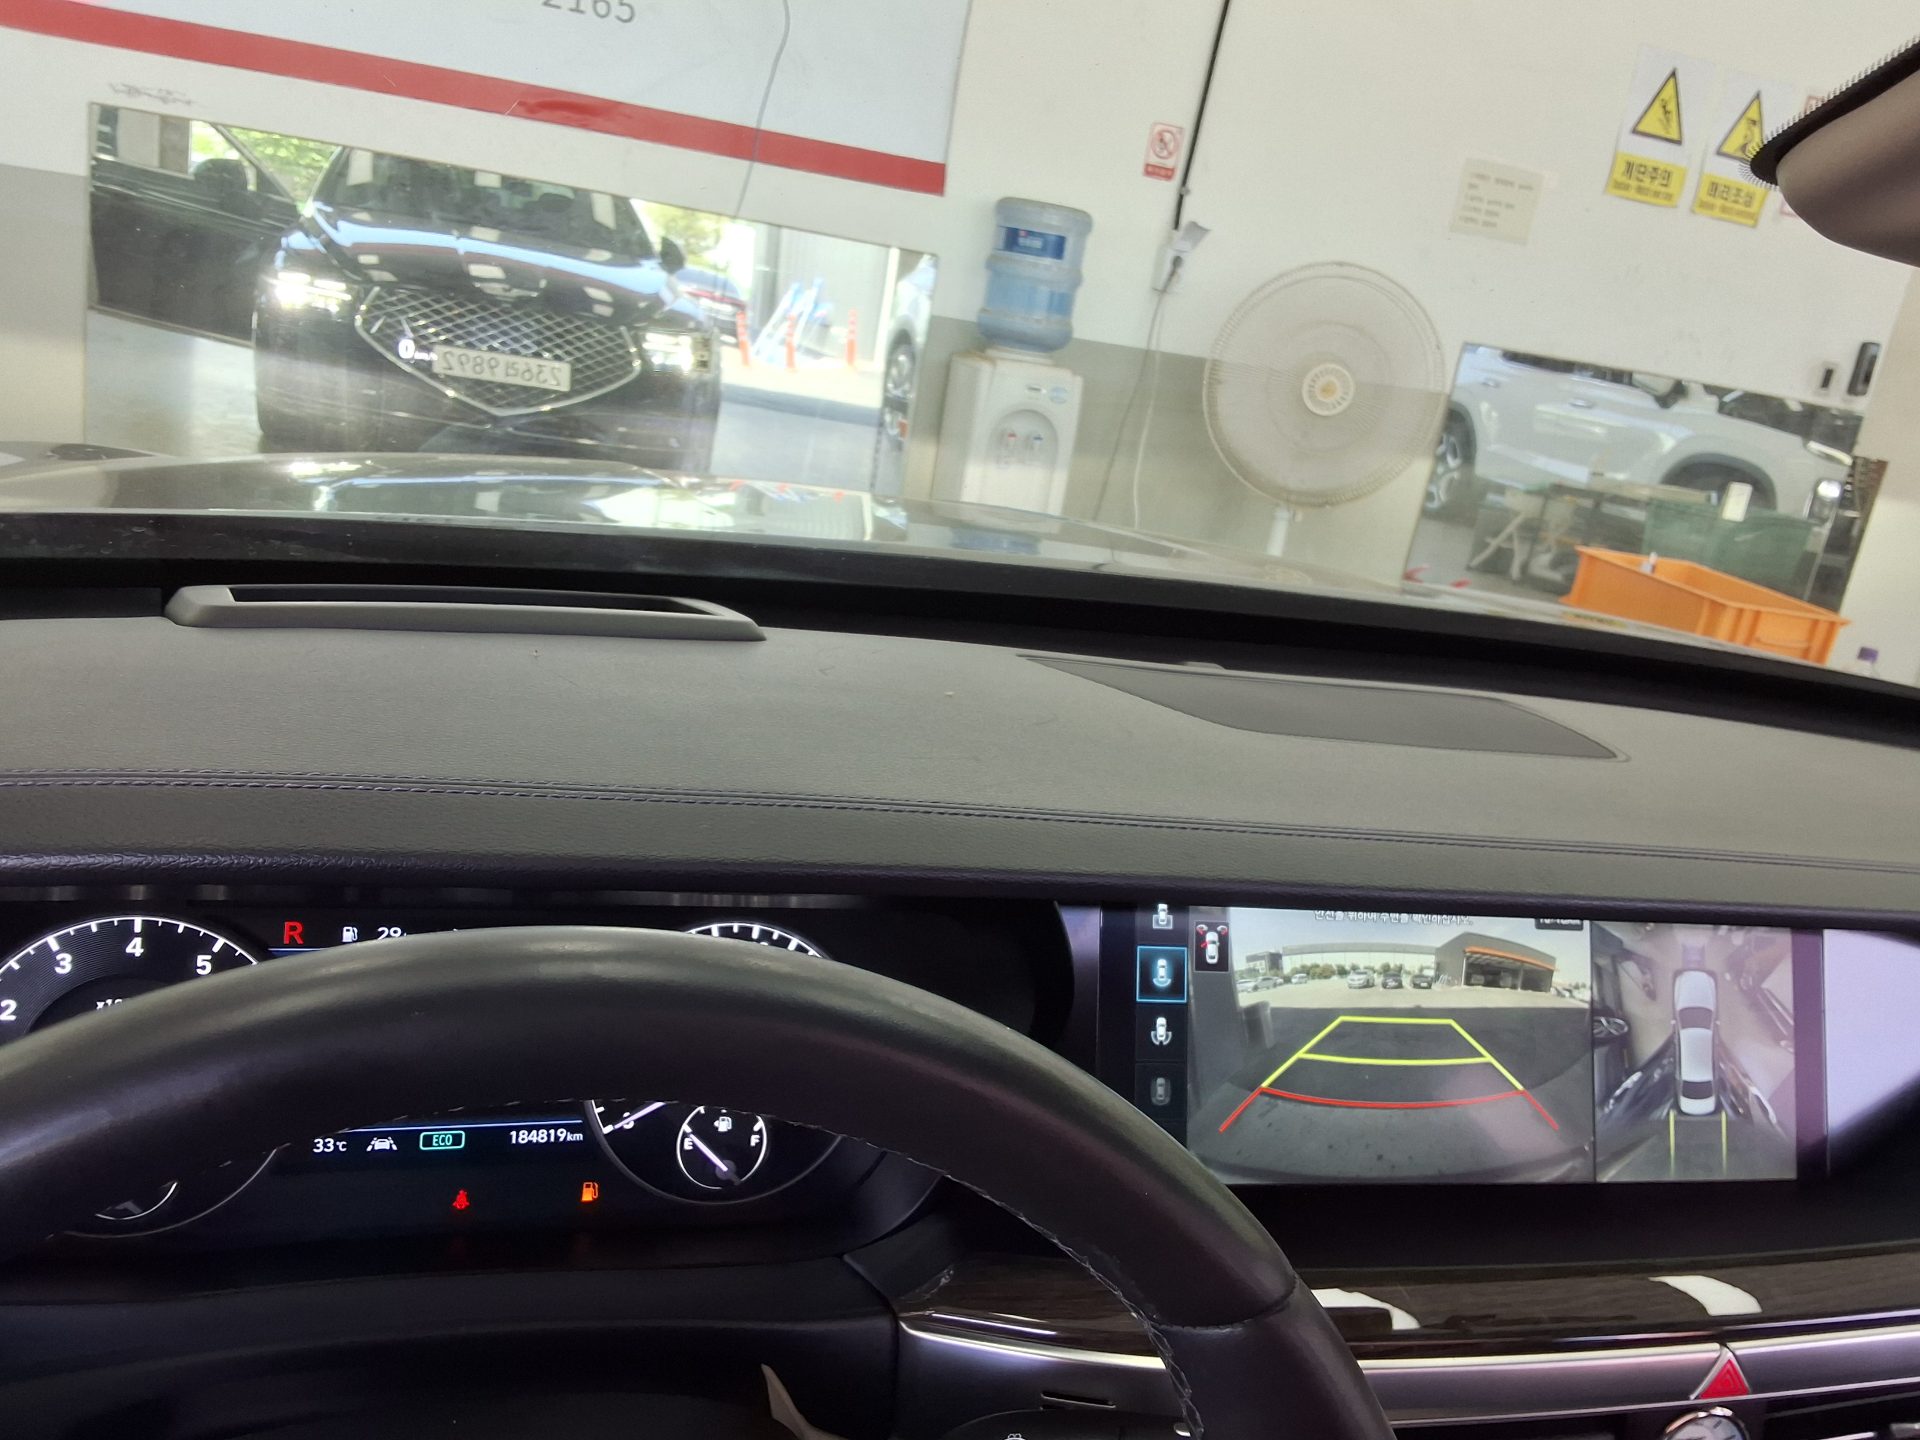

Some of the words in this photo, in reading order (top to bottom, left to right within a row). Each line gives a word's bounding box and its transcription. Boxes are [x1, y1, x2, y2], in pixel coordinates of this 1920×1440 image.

[283, 921, 304, 944] R
[125, 937, 144, 957] 4
[54, 953, 73, 974] 3
[196, 955, 212, 975] 5
[0, 1000, 17, 1021] 2
[432, 1134, 453, 1147] ECO
[683, 1136, 694, 1151] E
[750, 1134, 761, 1147] F
